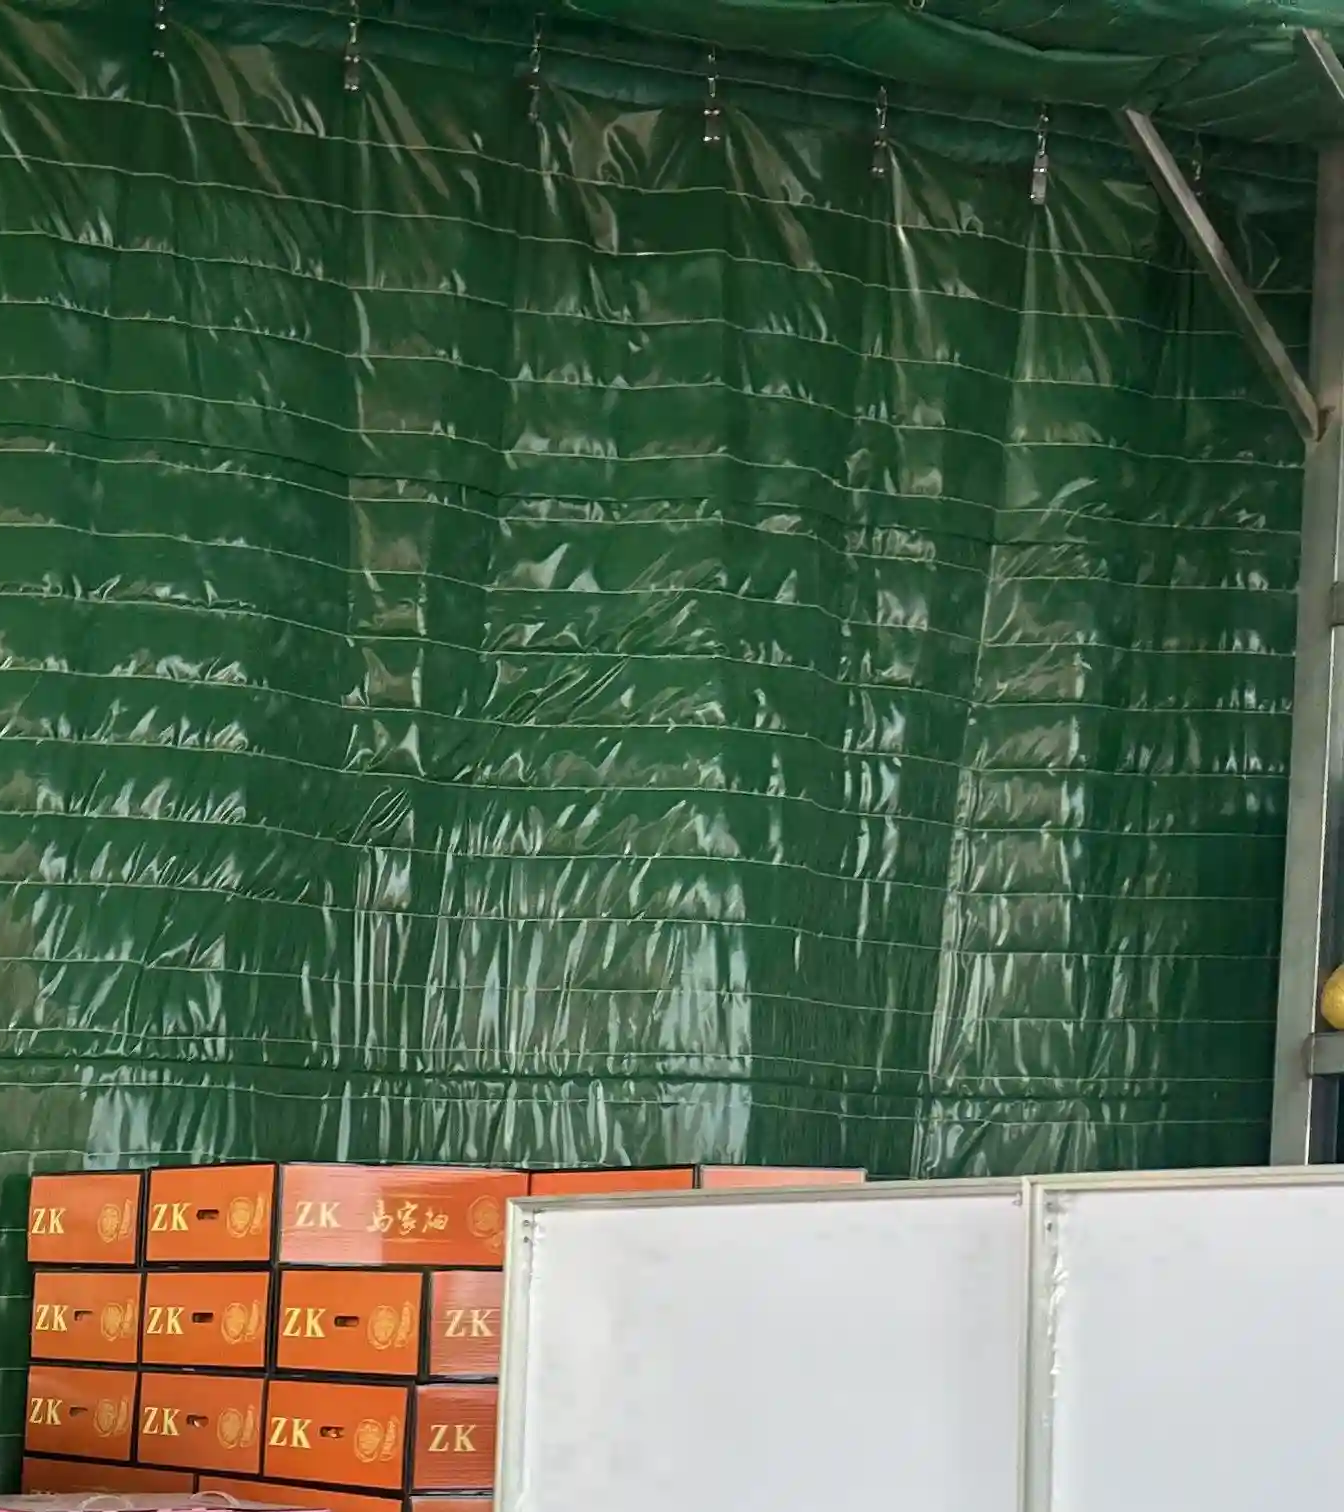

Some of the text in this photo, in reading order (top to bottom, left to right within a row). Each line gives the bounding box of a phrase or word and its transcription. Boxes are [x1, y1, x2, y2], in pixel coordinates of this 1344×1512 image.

[31, 1207, 65, 1235] ZK
[152, 1202, 190, 1232] ZK
[295, 1201, 341, 1229] ZK
[35, 1303, 69, 1332] ZK
[146, 1306, 185, 1335] ZK
[282, 1306, 326, 1338] ZK
[444, 1309, 494, 1337] ZK
[29, 1397, 63, 1425] ZK
[142, 1406, 181, 1436] ZK
[269, 1416, 312, 1449] ZK
[429, 1424, 477, 1452] ZK
